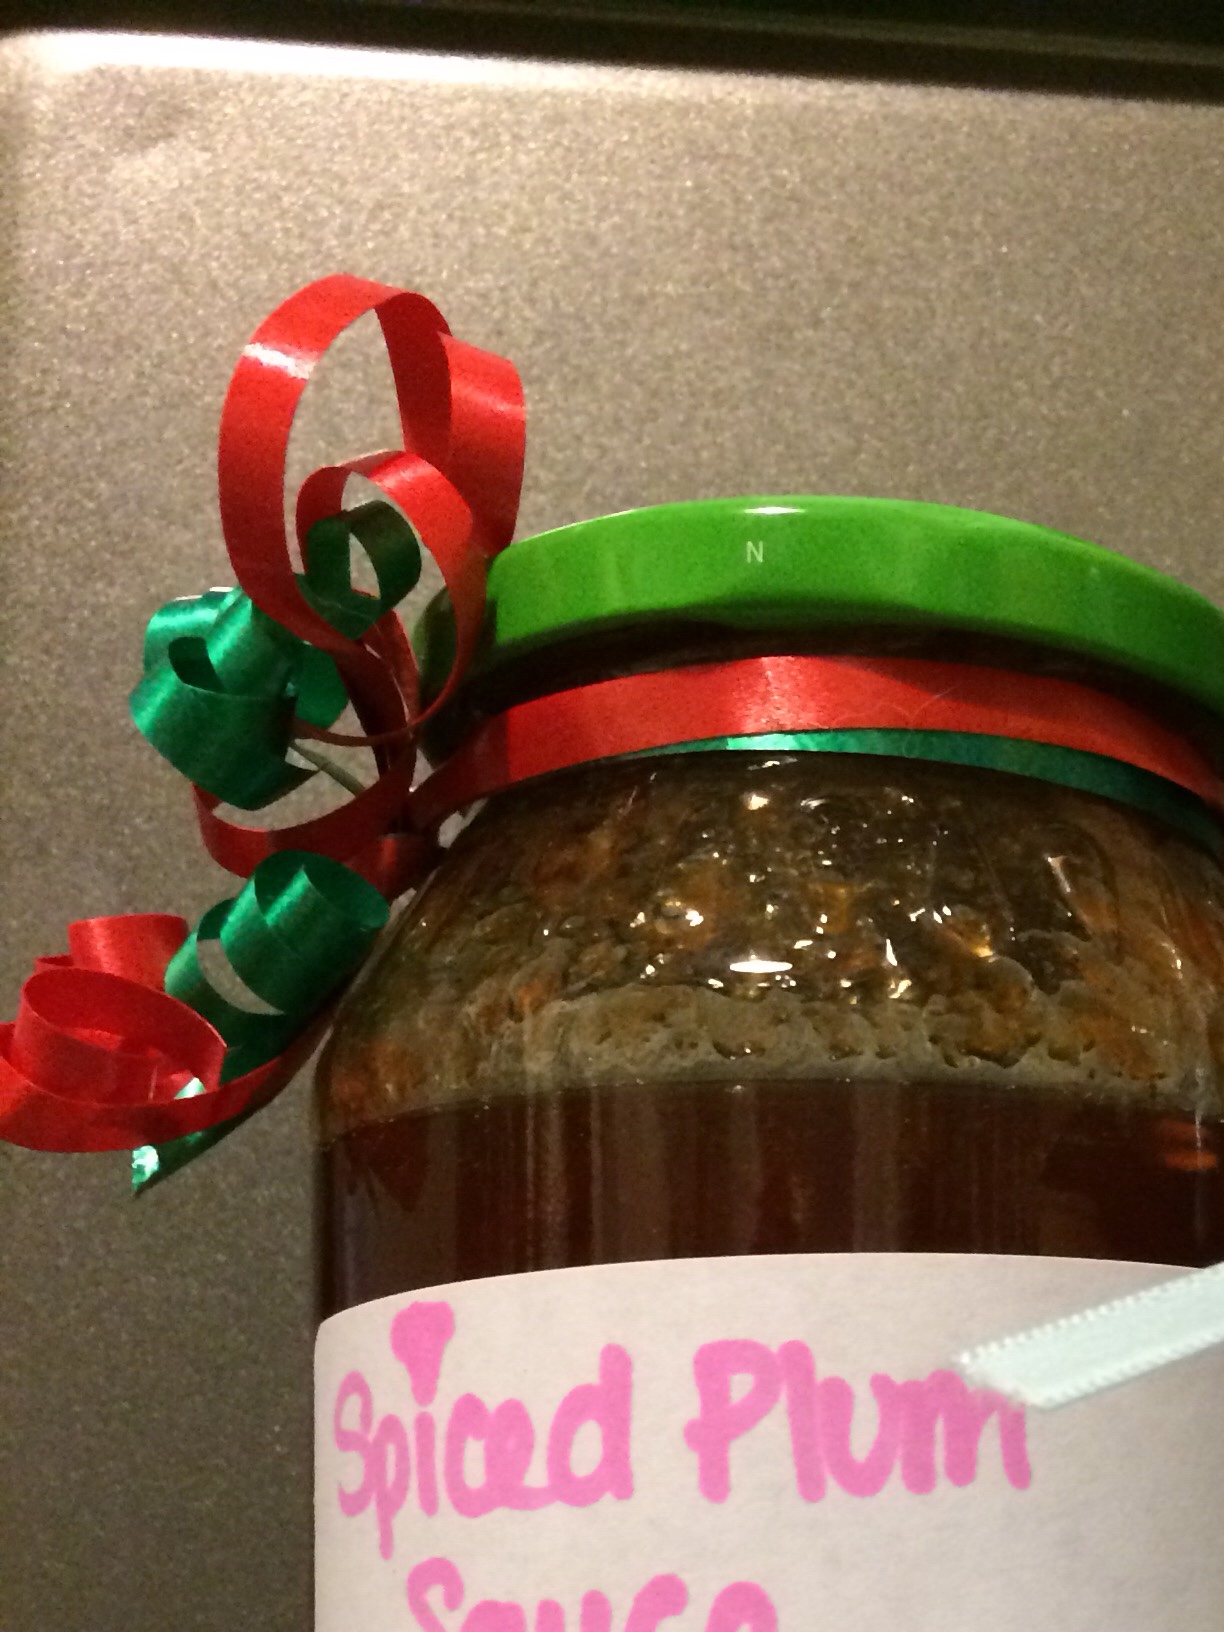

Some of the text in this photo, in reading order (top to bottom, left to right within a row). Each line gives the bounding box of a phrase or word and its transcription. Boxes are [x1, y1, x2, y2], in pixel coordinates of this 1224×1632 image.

[746, 540, 764, 563] N
[334, 1301, 1031, 1559] Spiced Plum
